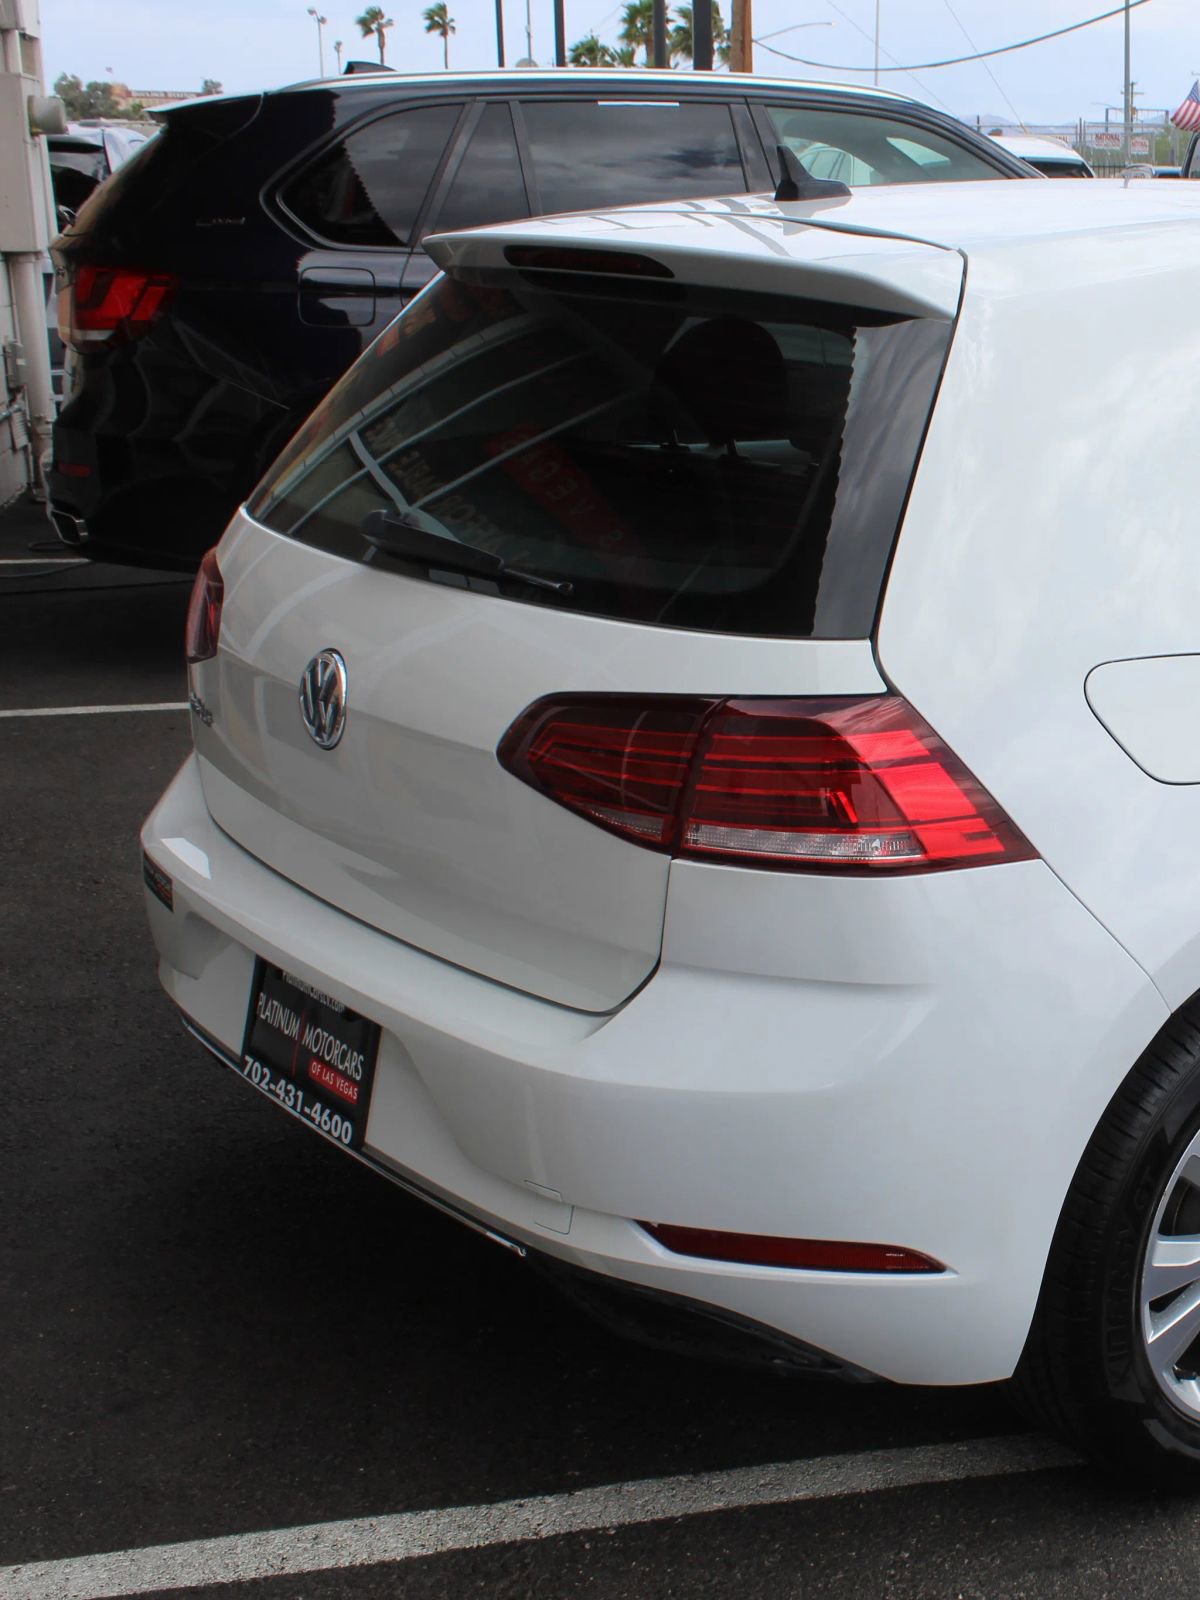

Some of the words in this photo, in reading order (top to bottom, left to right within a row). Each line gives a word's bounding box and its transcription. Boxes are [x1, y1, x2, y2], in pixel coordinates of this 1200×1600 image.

[257, 992, 300, 1041] PLATINUM
[301, 1023, 364, 1081] MOTORCARS
[243, 1055, 352, 1145] 702-431-4600
[311, 1062, 321, 1076] OF
[322, 1065, 334, 1086] LAS
[336, 1075, 358, 1101] VEGAS
